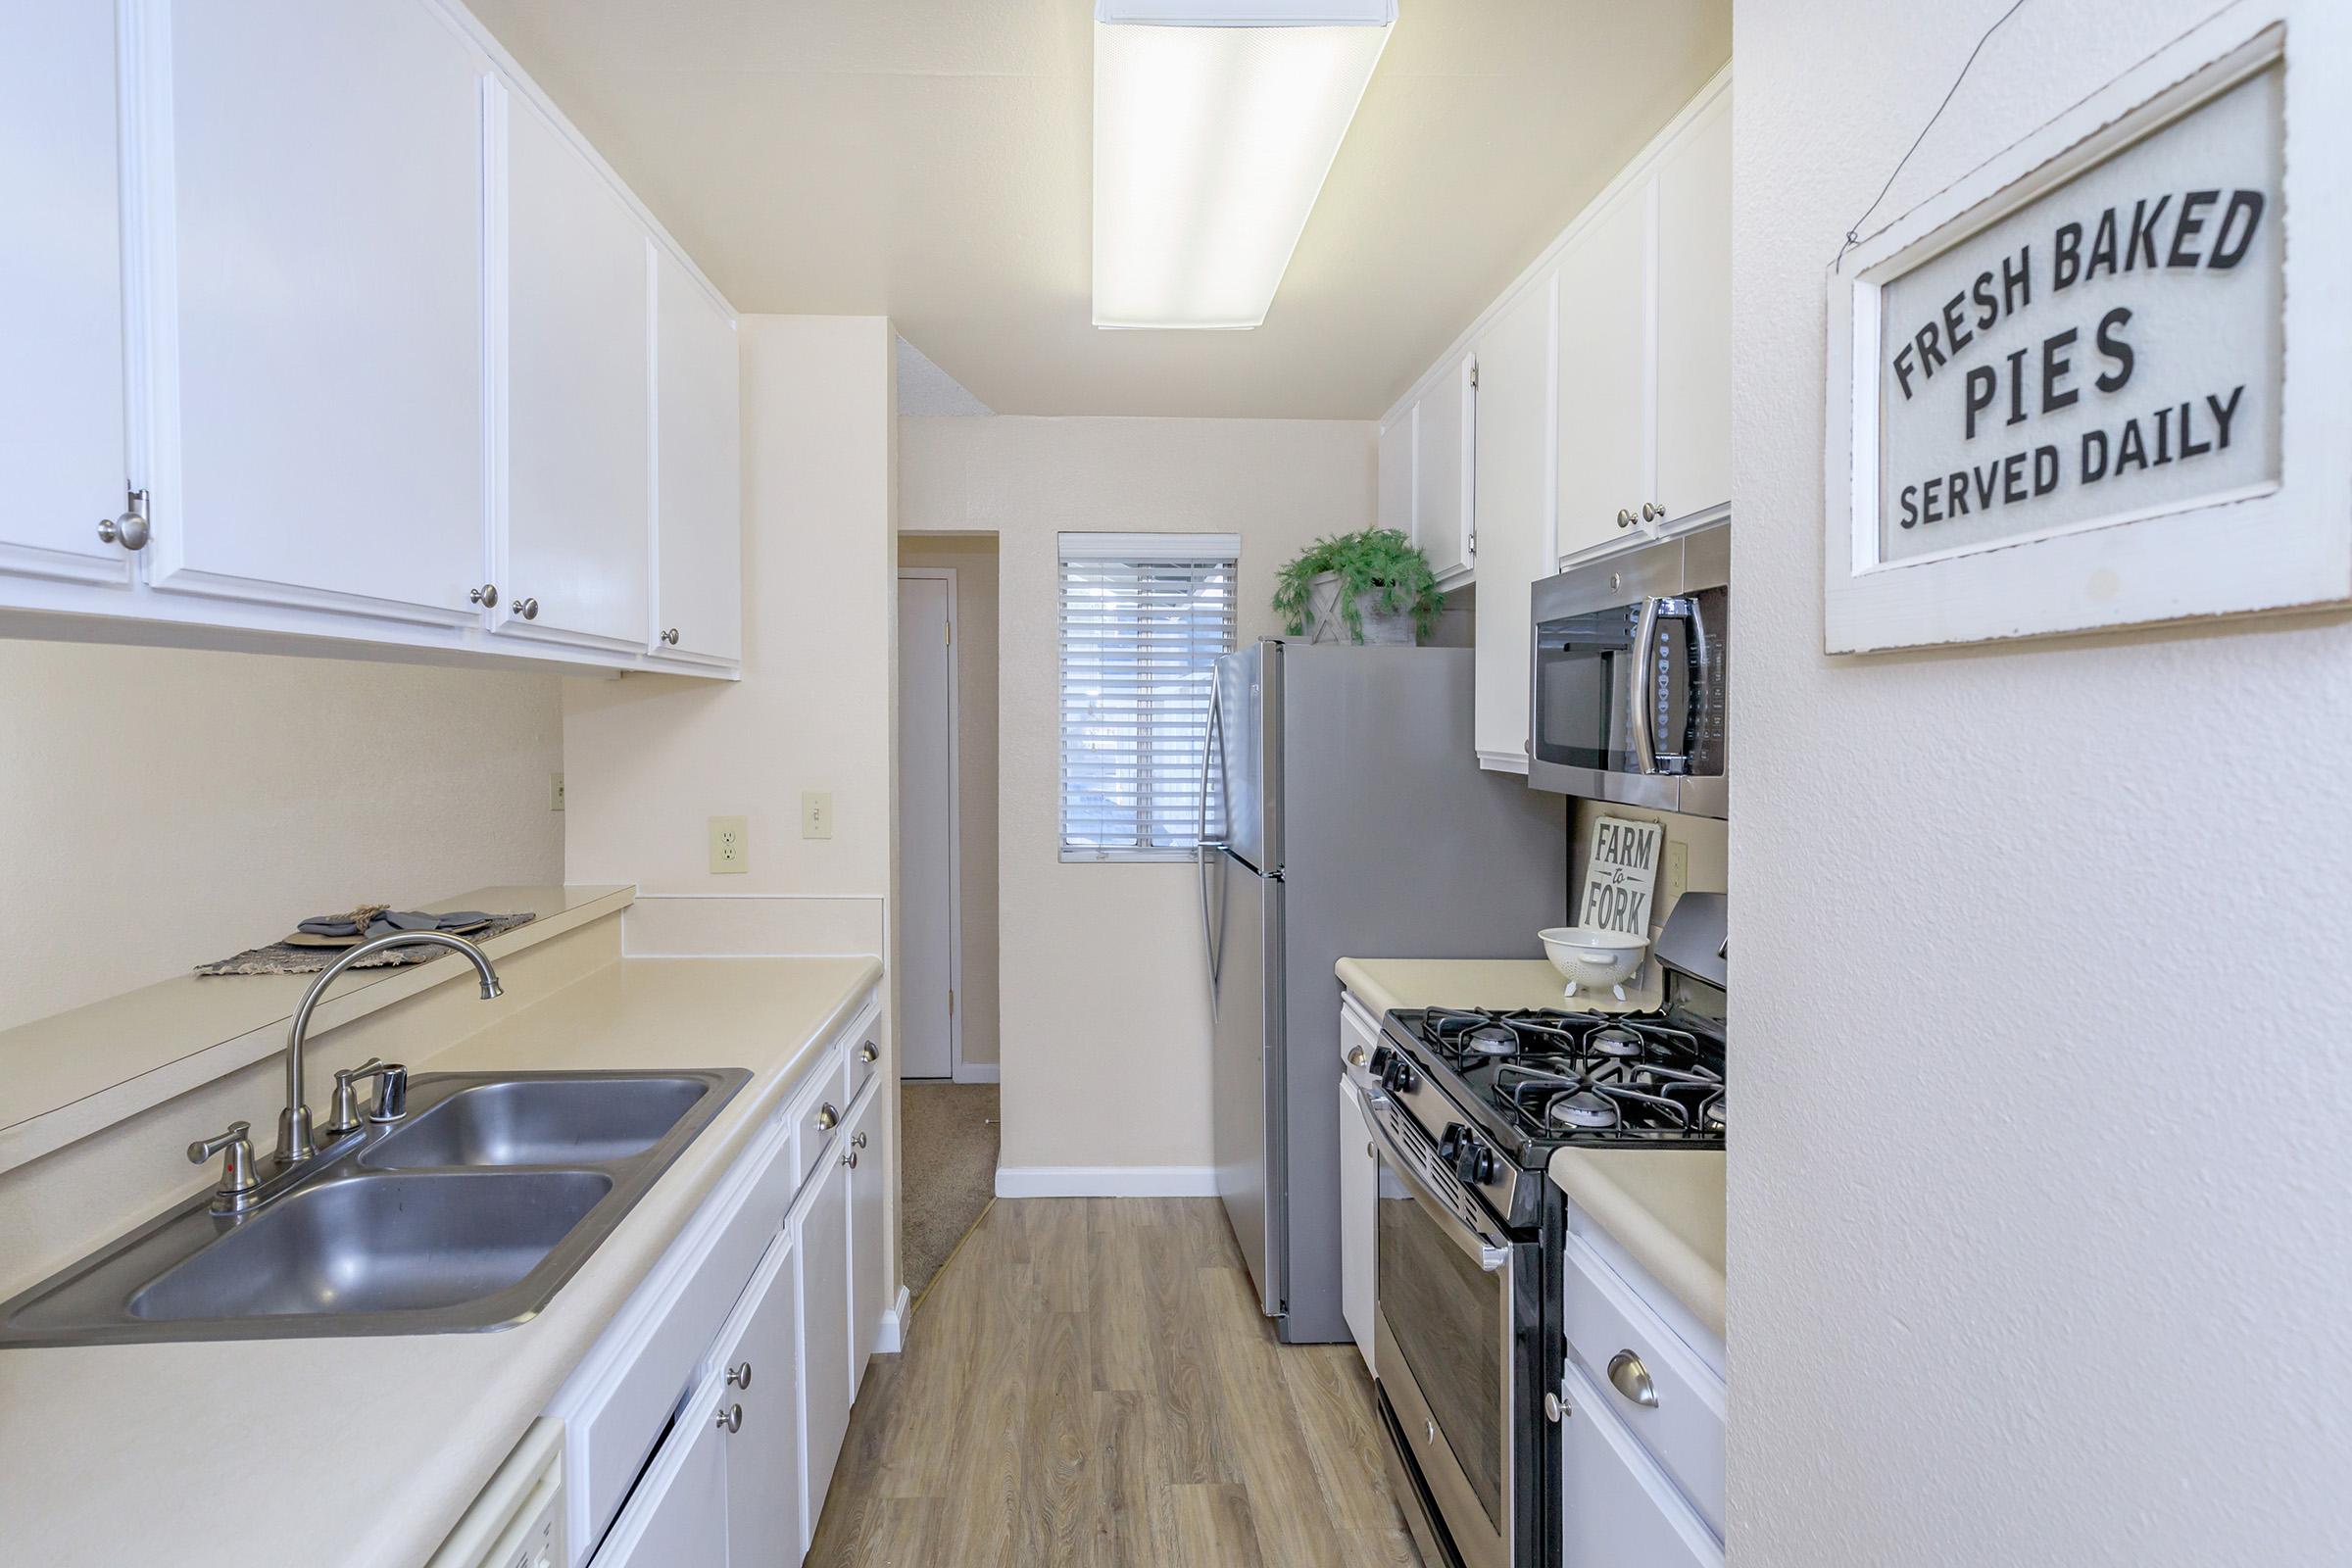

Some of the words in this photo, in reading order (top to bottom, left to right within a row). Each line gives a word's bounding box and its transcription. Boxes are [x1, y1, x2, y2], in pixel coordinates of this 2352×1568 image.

[1892, 244, 2032, 401] FRESH
[2052, 188, 2267, 293] BAKED
[1965, 307, 2135, 441] PIES
[1899, 444, 2061, 530] SERVED
[2081, 385, 2246, 486] DAILY
[1594, 822, 1655, 871] FARM
[1612, 867, 1626, 885] to
[1584, 880, 1646, 936] FORK
